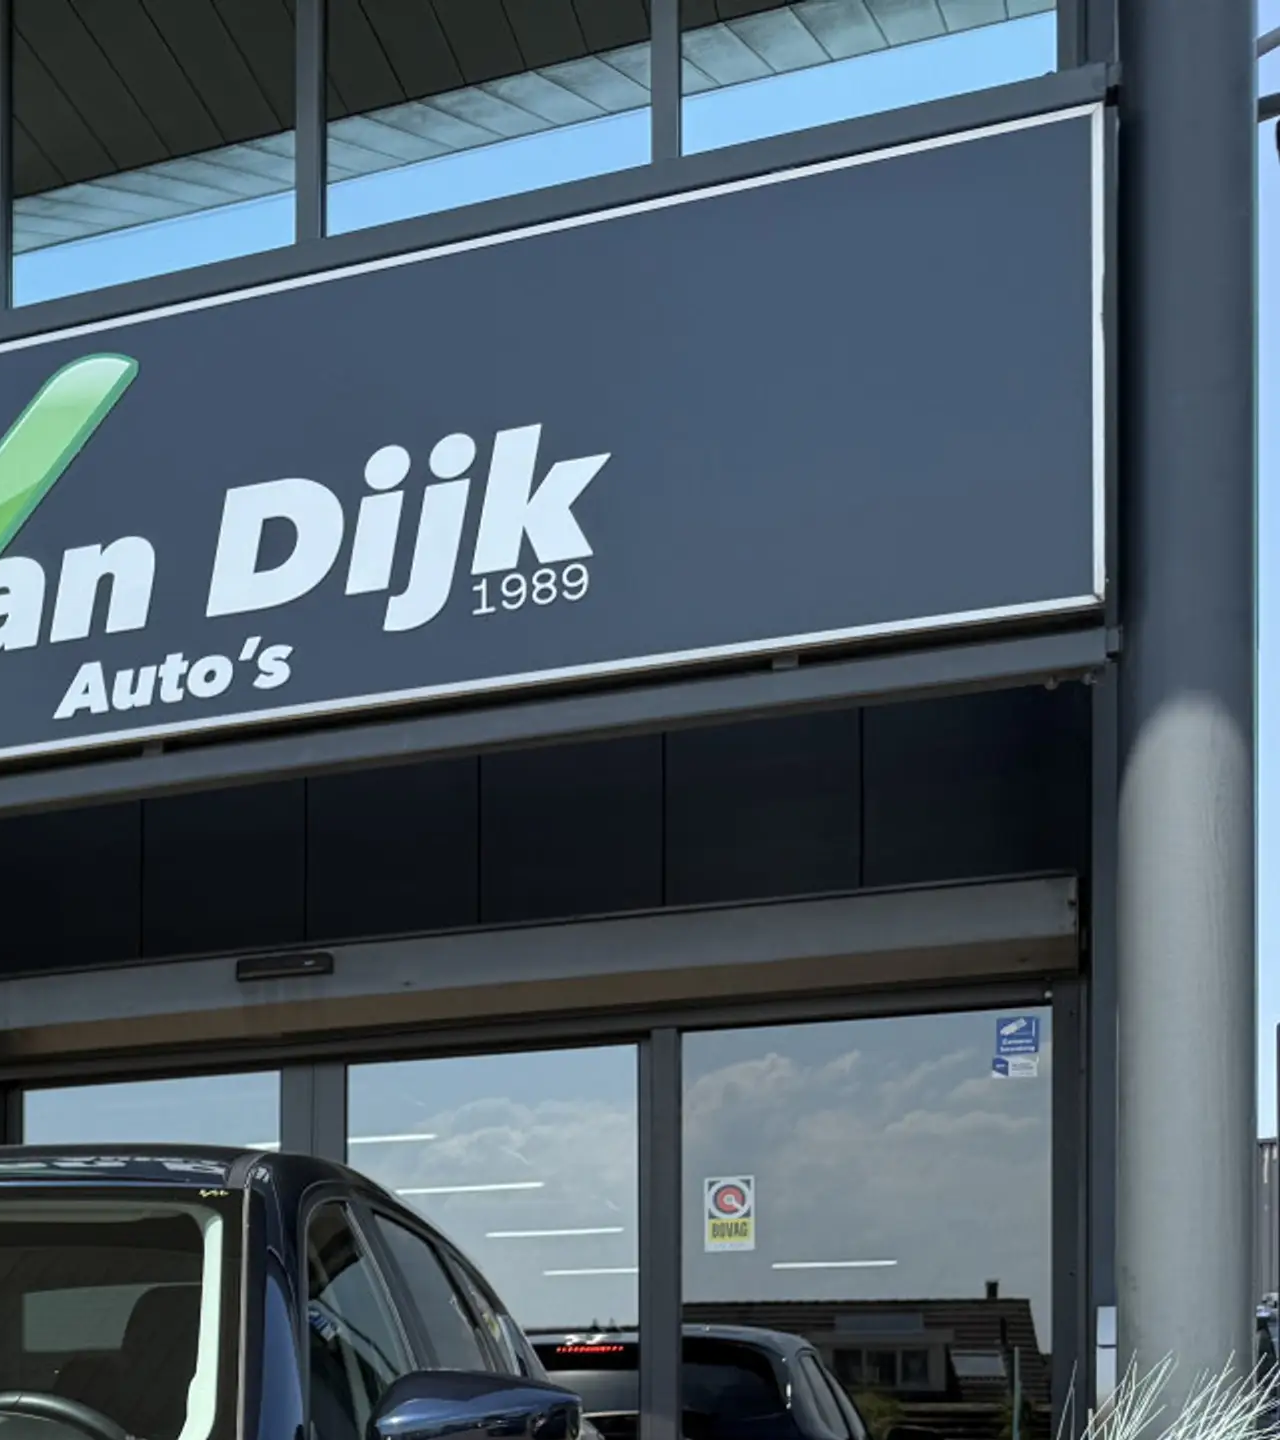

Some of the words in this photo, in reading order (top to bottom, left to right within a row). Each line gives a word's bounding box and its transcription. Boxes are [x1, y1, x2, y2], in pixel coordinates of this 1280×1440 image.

[206, 422, 611, 632] Dijk
[471, 563, 590, 615] 1989
[54, 637, 293, 720] Auto's
[712, 1221, 748, 1238] BOVAG
